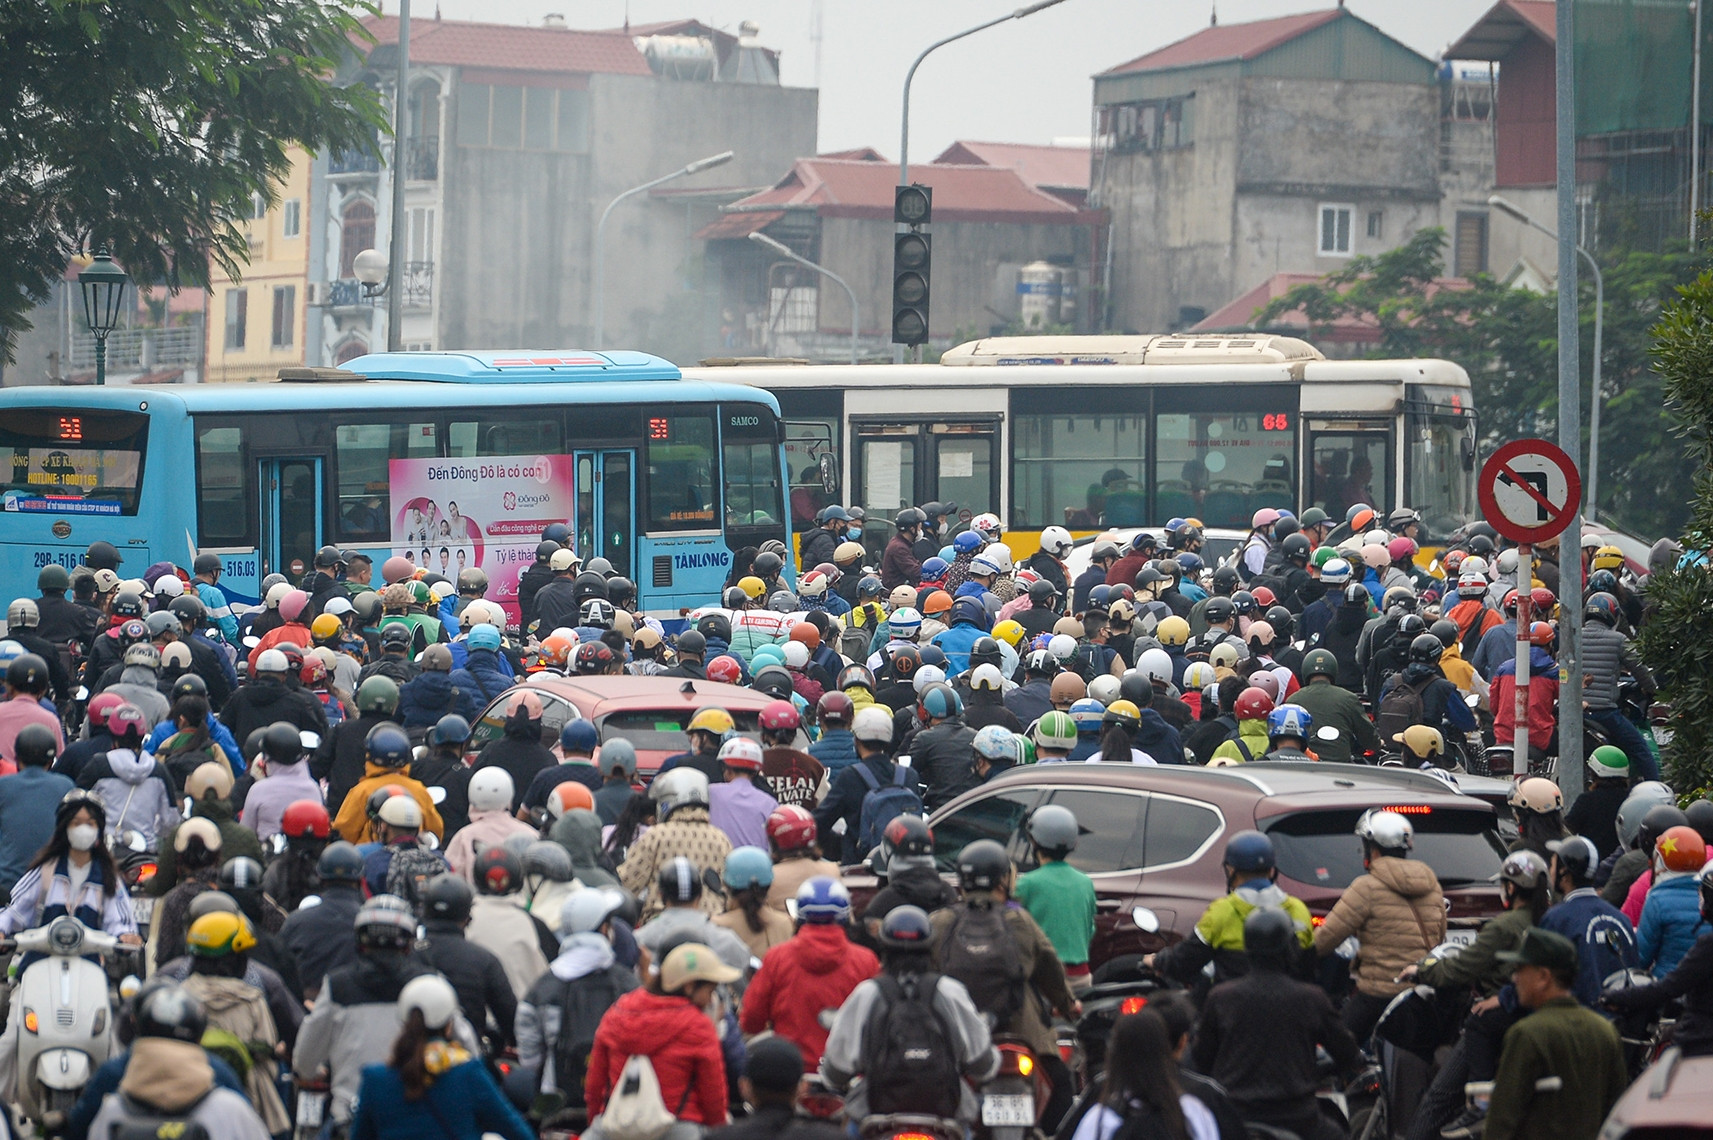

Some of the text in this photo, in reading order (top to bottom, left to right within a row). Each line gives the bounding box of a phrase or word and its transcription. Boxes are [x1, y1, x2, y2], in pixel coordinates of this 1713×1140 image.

[731, 416, 759, 426] SAMCO
[51, 455, 61, 467] XE
[28, 473, 60, 484] HOTLINE:
[428, 465, 449, 480] Đến
[450, 465, 479, 482] Đông
[480, 464, 494, 479] Đô
[497, 464, 506, 478] là
[508, 464, 520, 478] có
[518, 493, 550, 505] Đông Đô
[508, 548, 516, 564] lệ
[518, 548, 537, 561] thàn
[778, 789, 812, 802] IVATE
